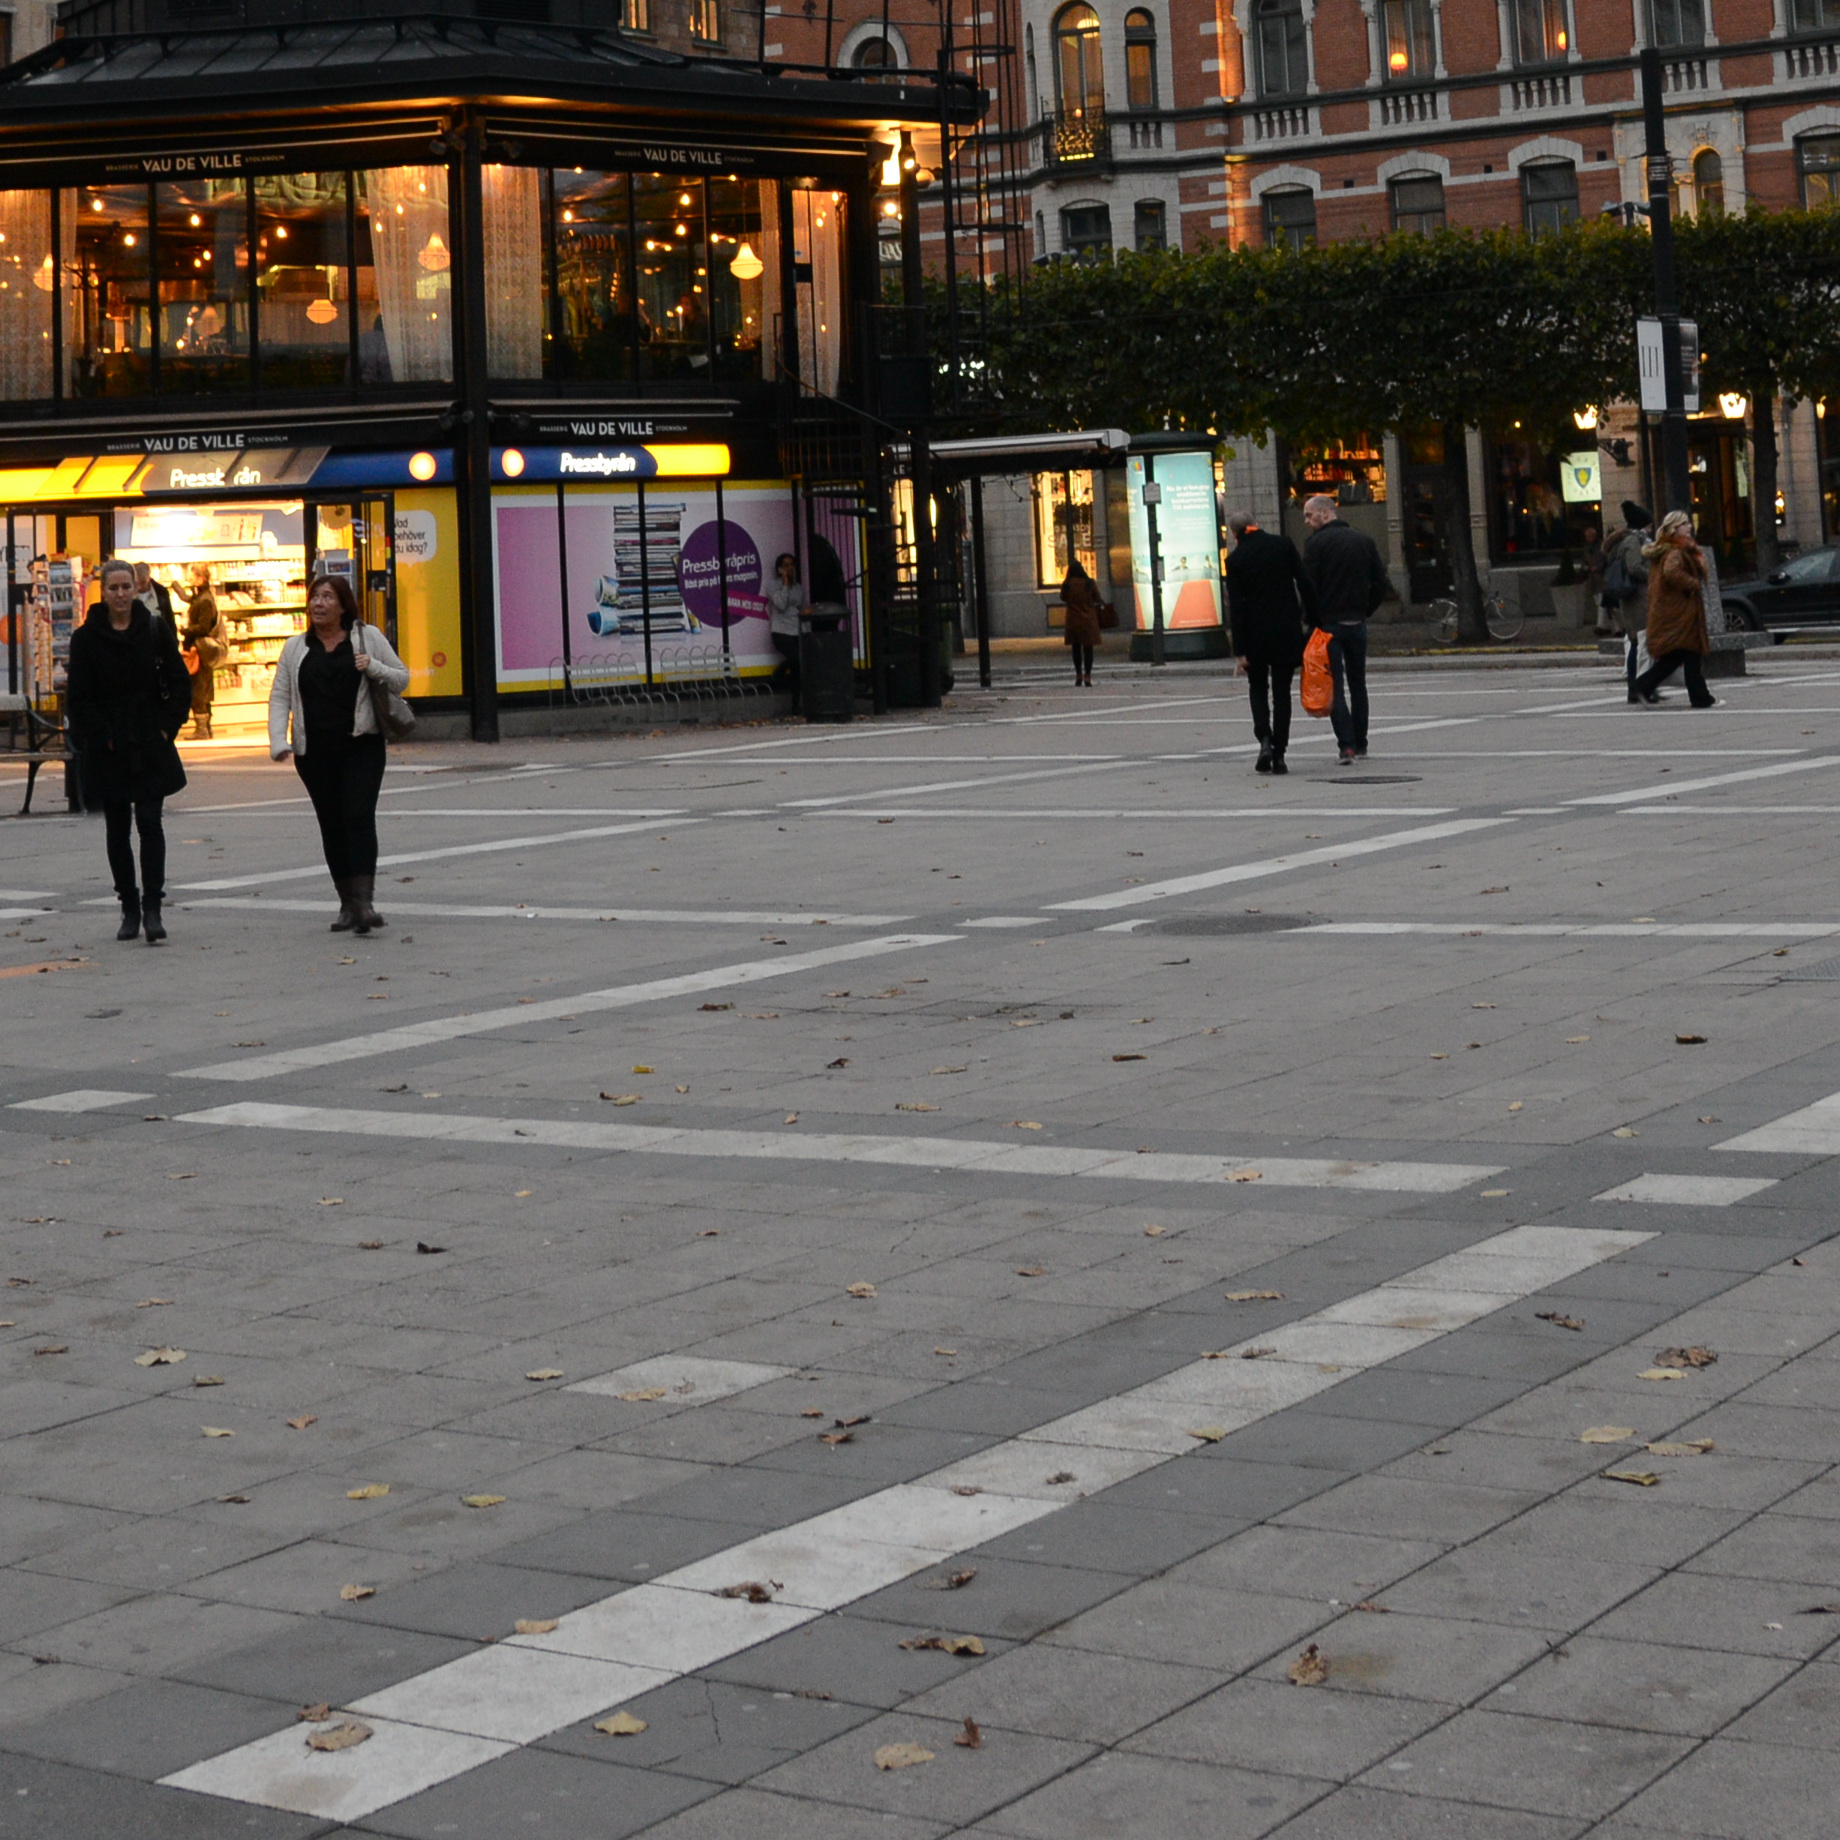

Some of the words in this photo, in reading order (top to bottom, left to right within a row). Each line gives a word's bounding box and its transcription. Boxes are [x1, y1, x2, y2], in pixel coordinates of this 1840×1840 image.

[142, 160, 172, 172] VAU
[176, 157, 196, 171] DE
[199, 154, 242, 168] VILLE
[643, 148, 667, 161] VAU
[670, 150, 687, 163] DE
[689, 151, 722, 165] VILLE
[571, 422, 596, 435] VAU
[598, 422, 616, 435] DE
[618, 422, 653, 435] VILLE
[144, 438, 174, 451] VAU
[178, 436, 198, 450] DE
[202, 434, 245, 448] VILLE
[560, 452, 636, 475] Pressbyrån
[683, 552, 756, 574] Pressbråpris
